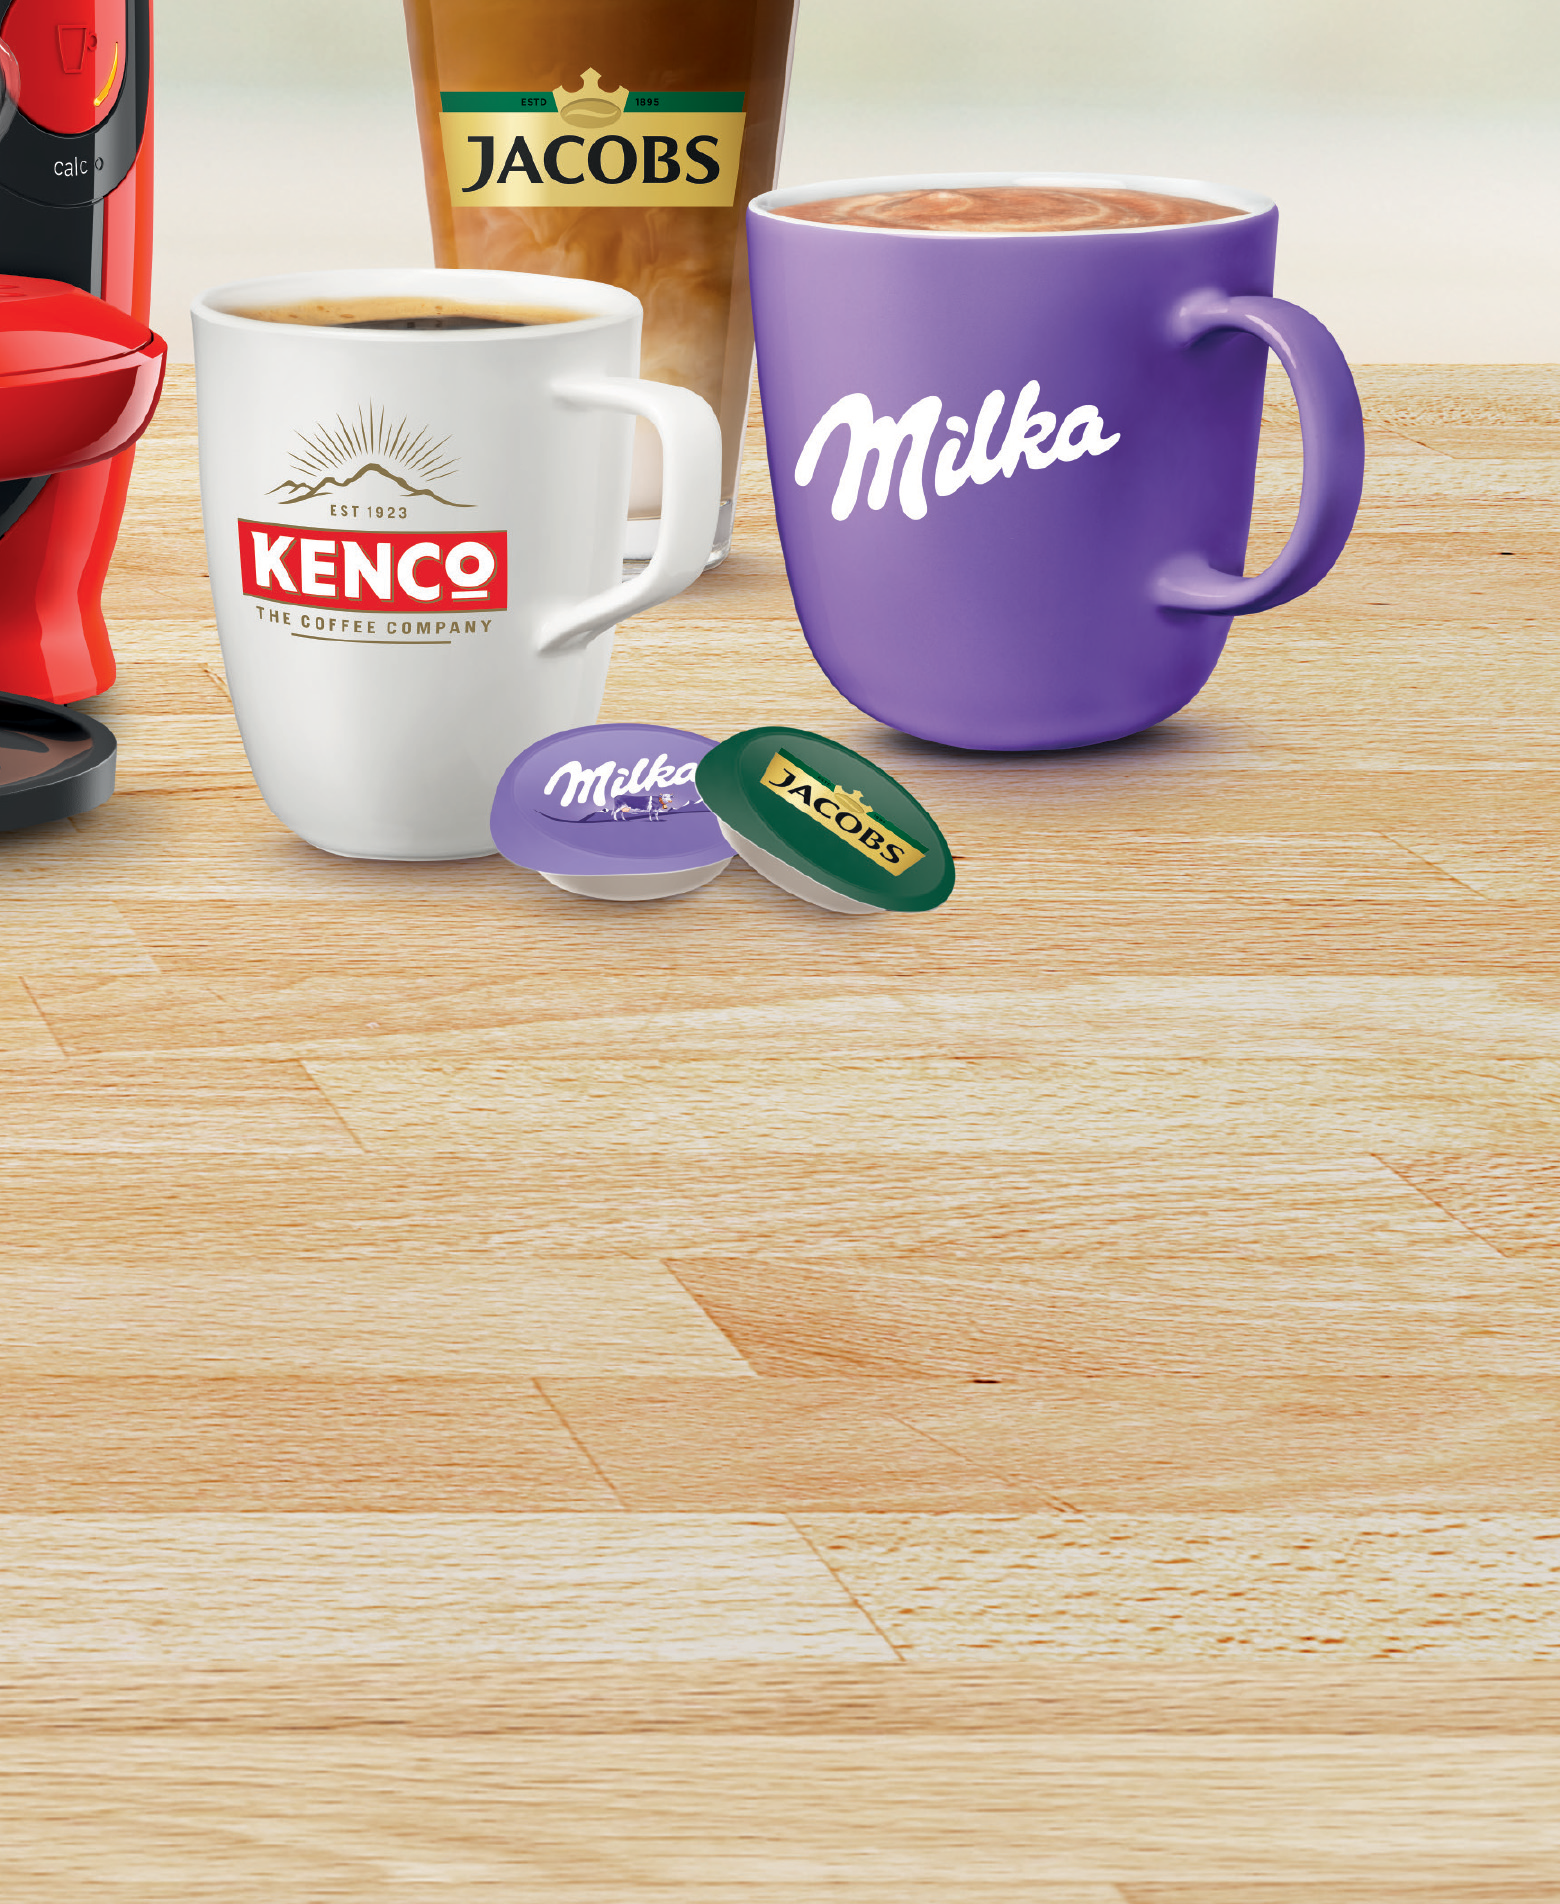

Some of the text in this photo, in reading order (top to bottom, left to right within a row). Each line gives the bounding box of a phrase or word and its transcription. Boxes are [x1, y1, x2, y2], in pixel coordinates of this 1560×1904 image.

[521, 97, 660, 107] ESTD 1895
[54, 157, 88, 176] calc
[462, 134, 720, 193] JACOBS
[794, 379, 1121, 521] Milka
[330, 504, 408, 519] EST 1923
[250, 531, 497, 603] KENCO
[255, 605, 492, 635] THE COFFEE COMPANY
[544, 753, 698, 807] Milka
[768, 768, 905, 864] JACOBS
